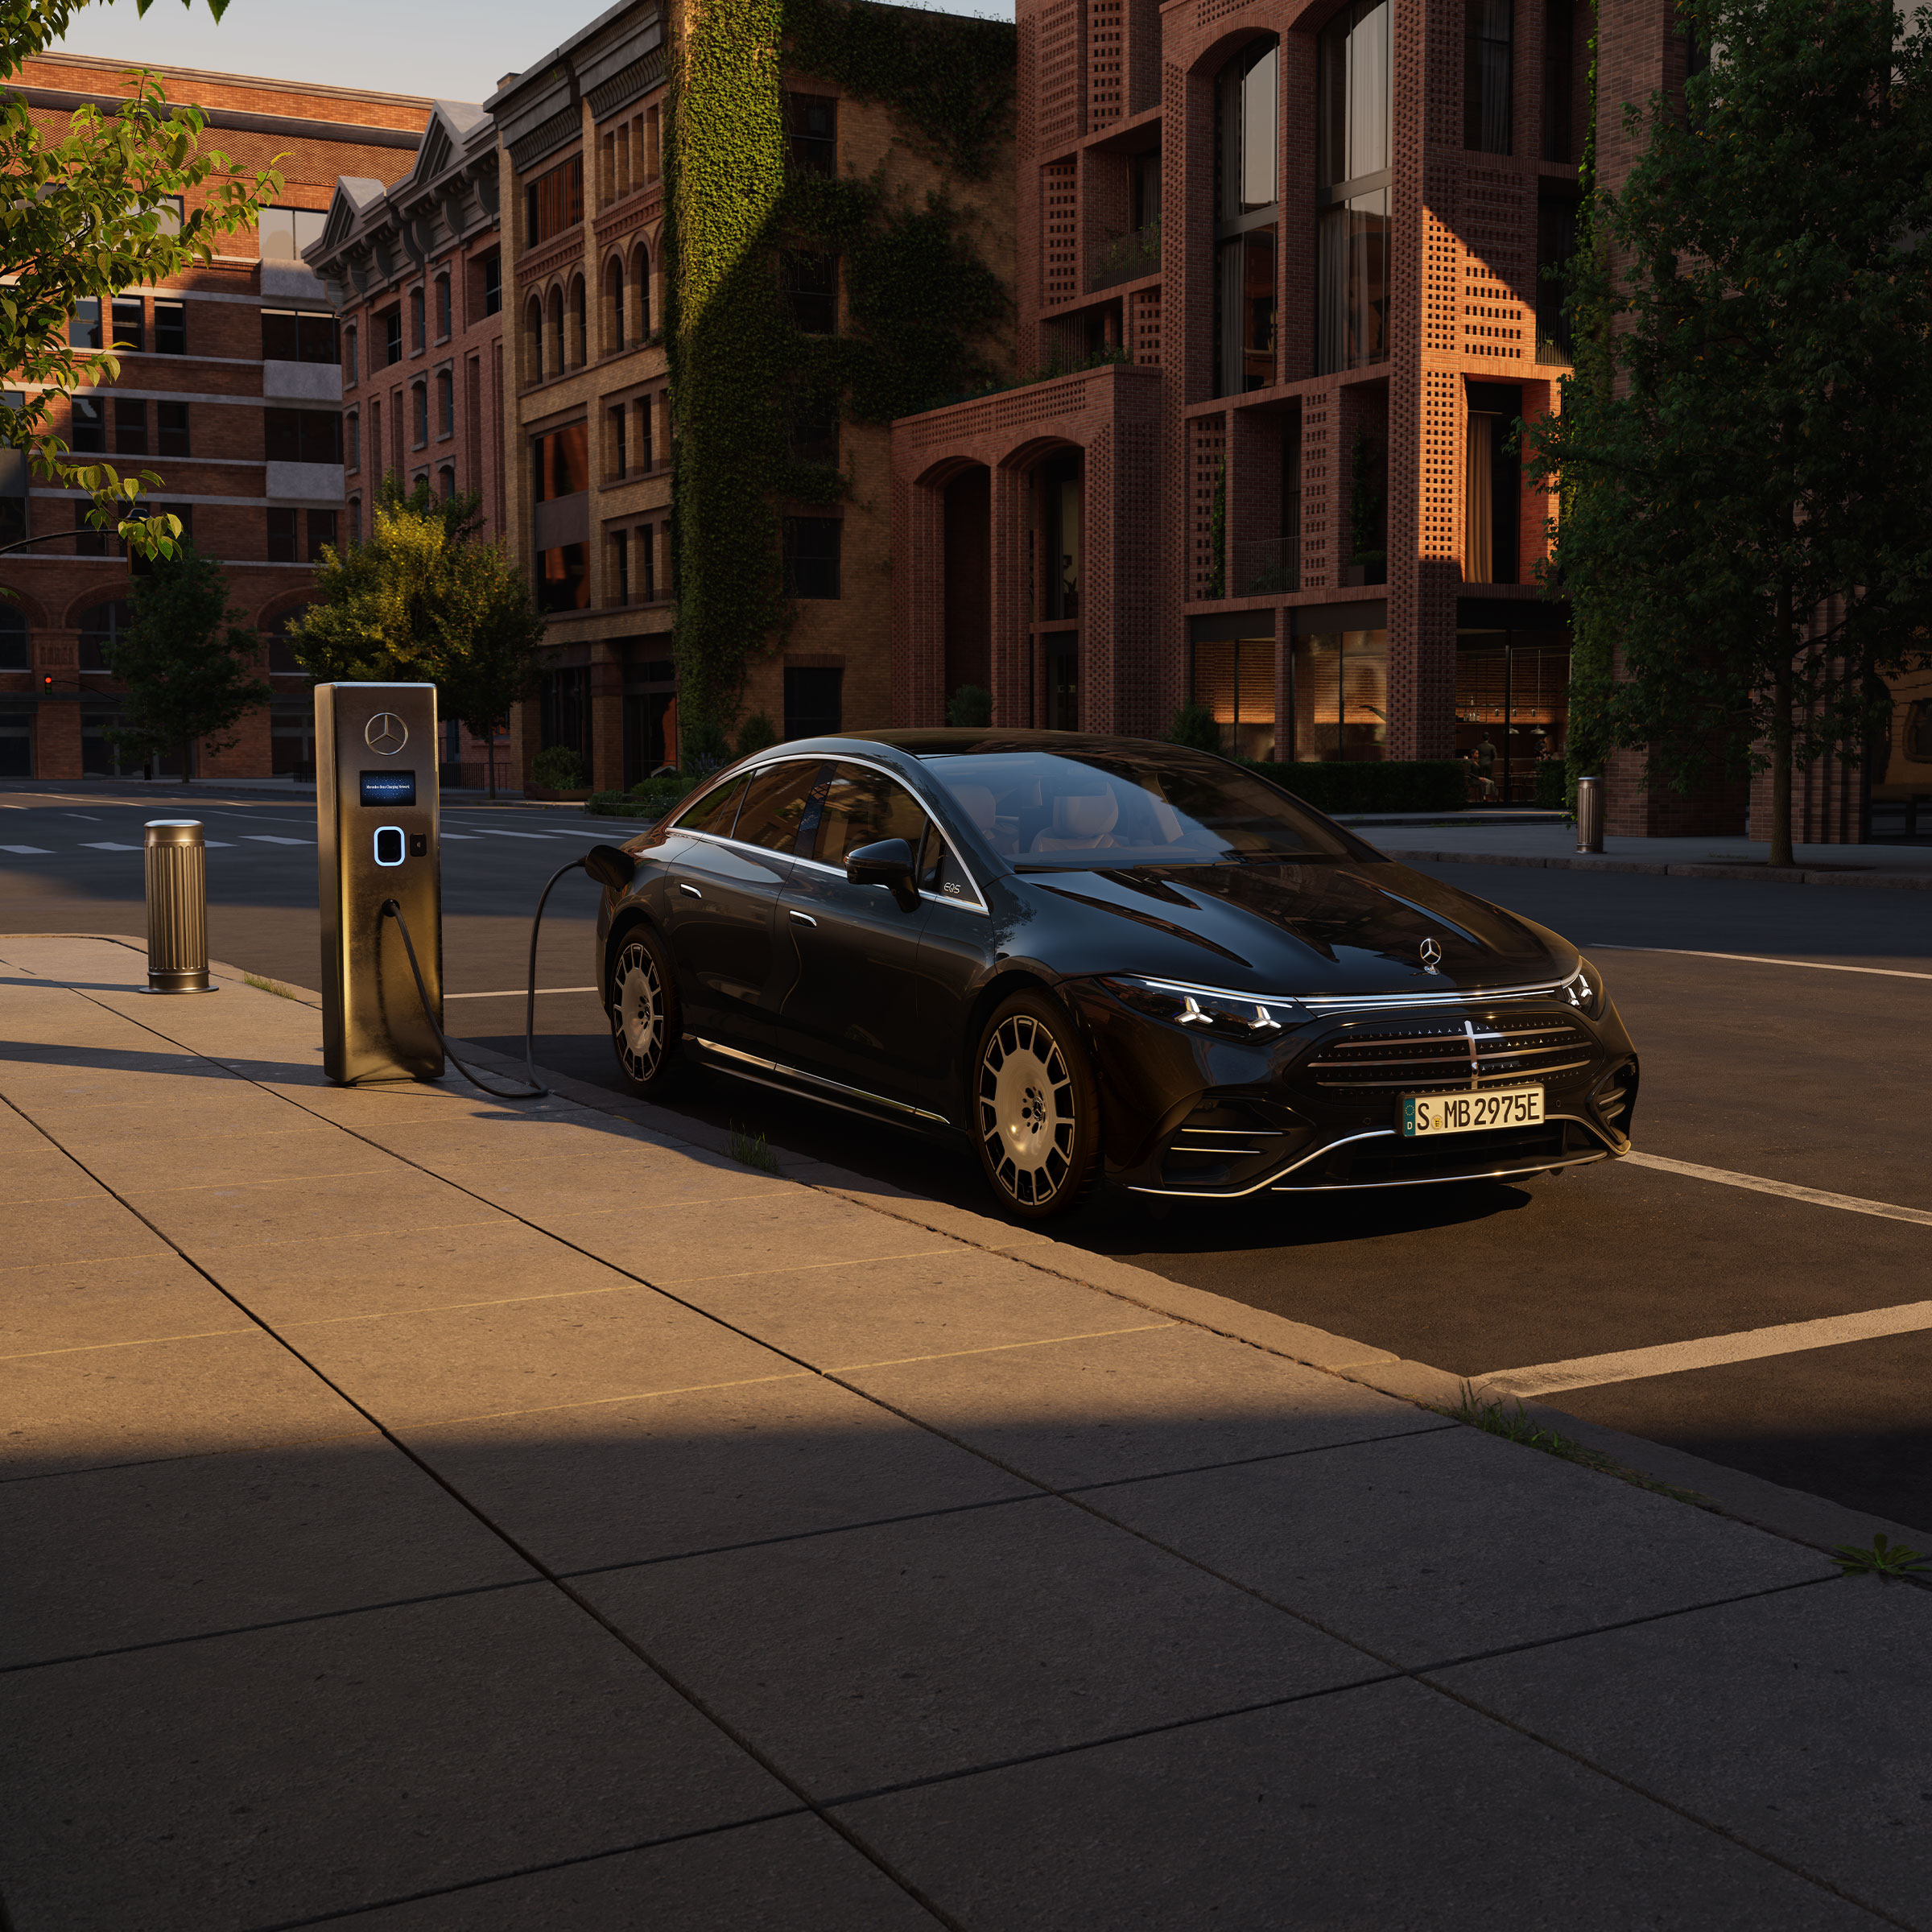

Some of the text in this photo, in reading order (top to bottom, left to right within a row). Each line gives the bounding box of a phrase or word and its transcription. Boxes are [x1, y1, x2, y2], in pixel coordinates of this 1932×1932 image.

[943, 881, 961, 894] EQS
[1417, 1092, 1539, 1130] S MB 2975E
[1406, 1121, 1413, 1130] D
